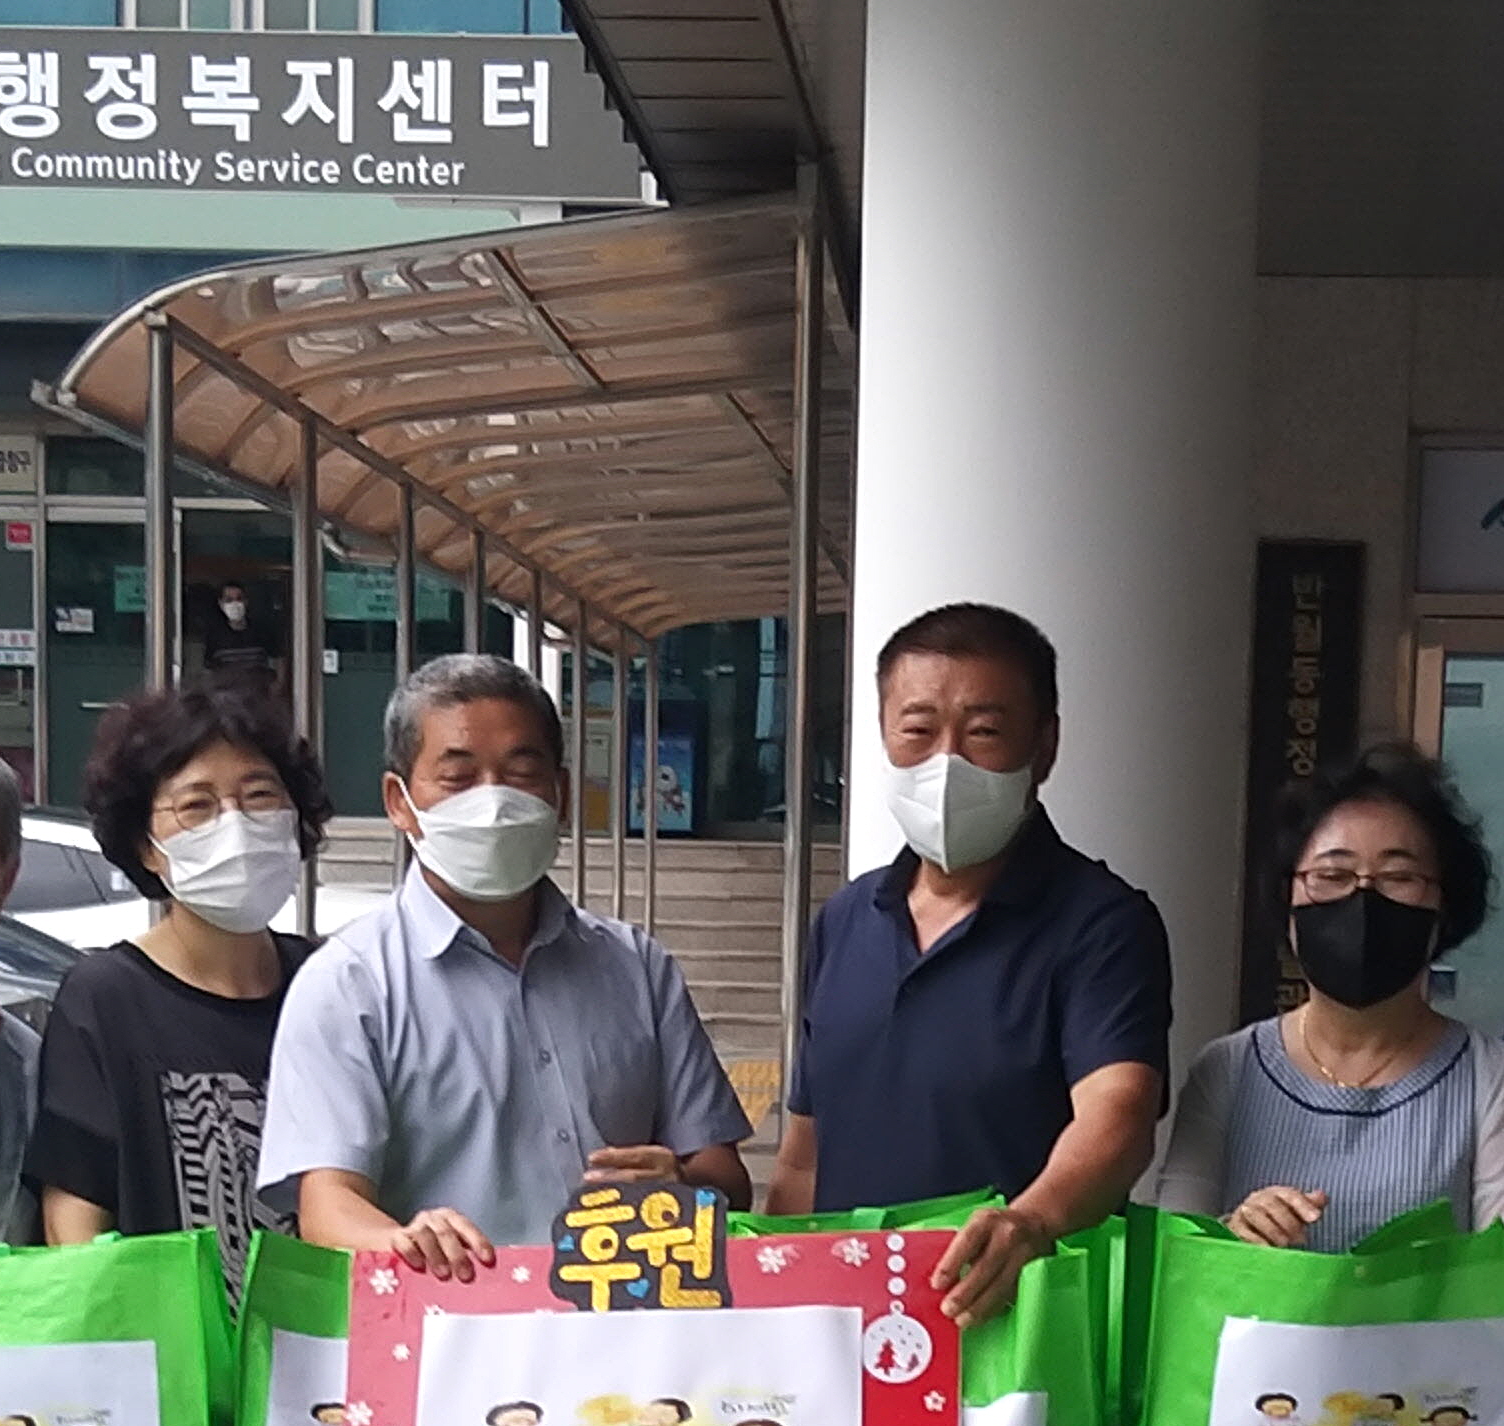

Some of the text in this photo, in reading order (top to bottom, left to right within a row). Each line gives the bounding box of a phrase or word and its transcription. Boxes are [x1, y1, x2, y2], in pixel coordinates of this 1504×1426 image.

[10, 148, 203, 188] Community
[213, 150, 343, 185] Service
[352, 154, 465, 187] Center
[558, 1187, 717, 1312] 후원
